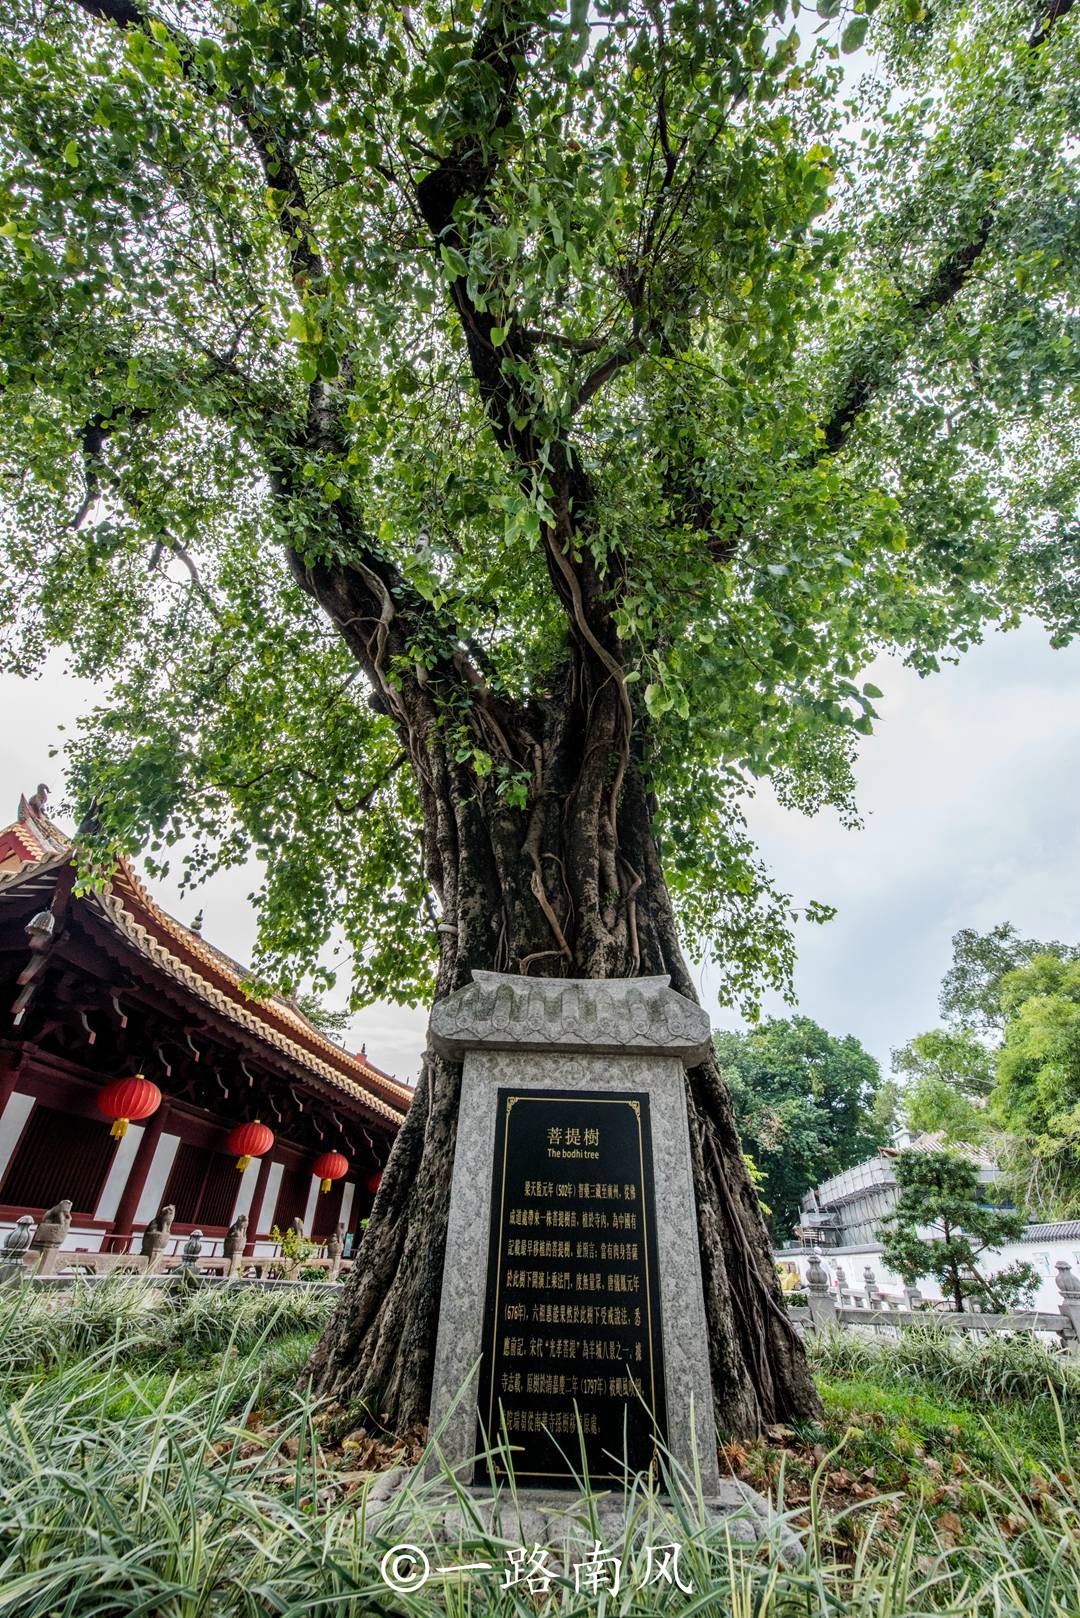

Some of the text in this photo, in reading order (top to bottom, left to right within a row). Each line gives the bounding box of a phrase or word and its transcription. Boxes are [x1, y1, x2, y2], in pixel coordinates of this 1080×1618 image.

[546, 1127, 600, 1146] 菩提樹
[547, 1148, 600, 1160] The bodhi tree
